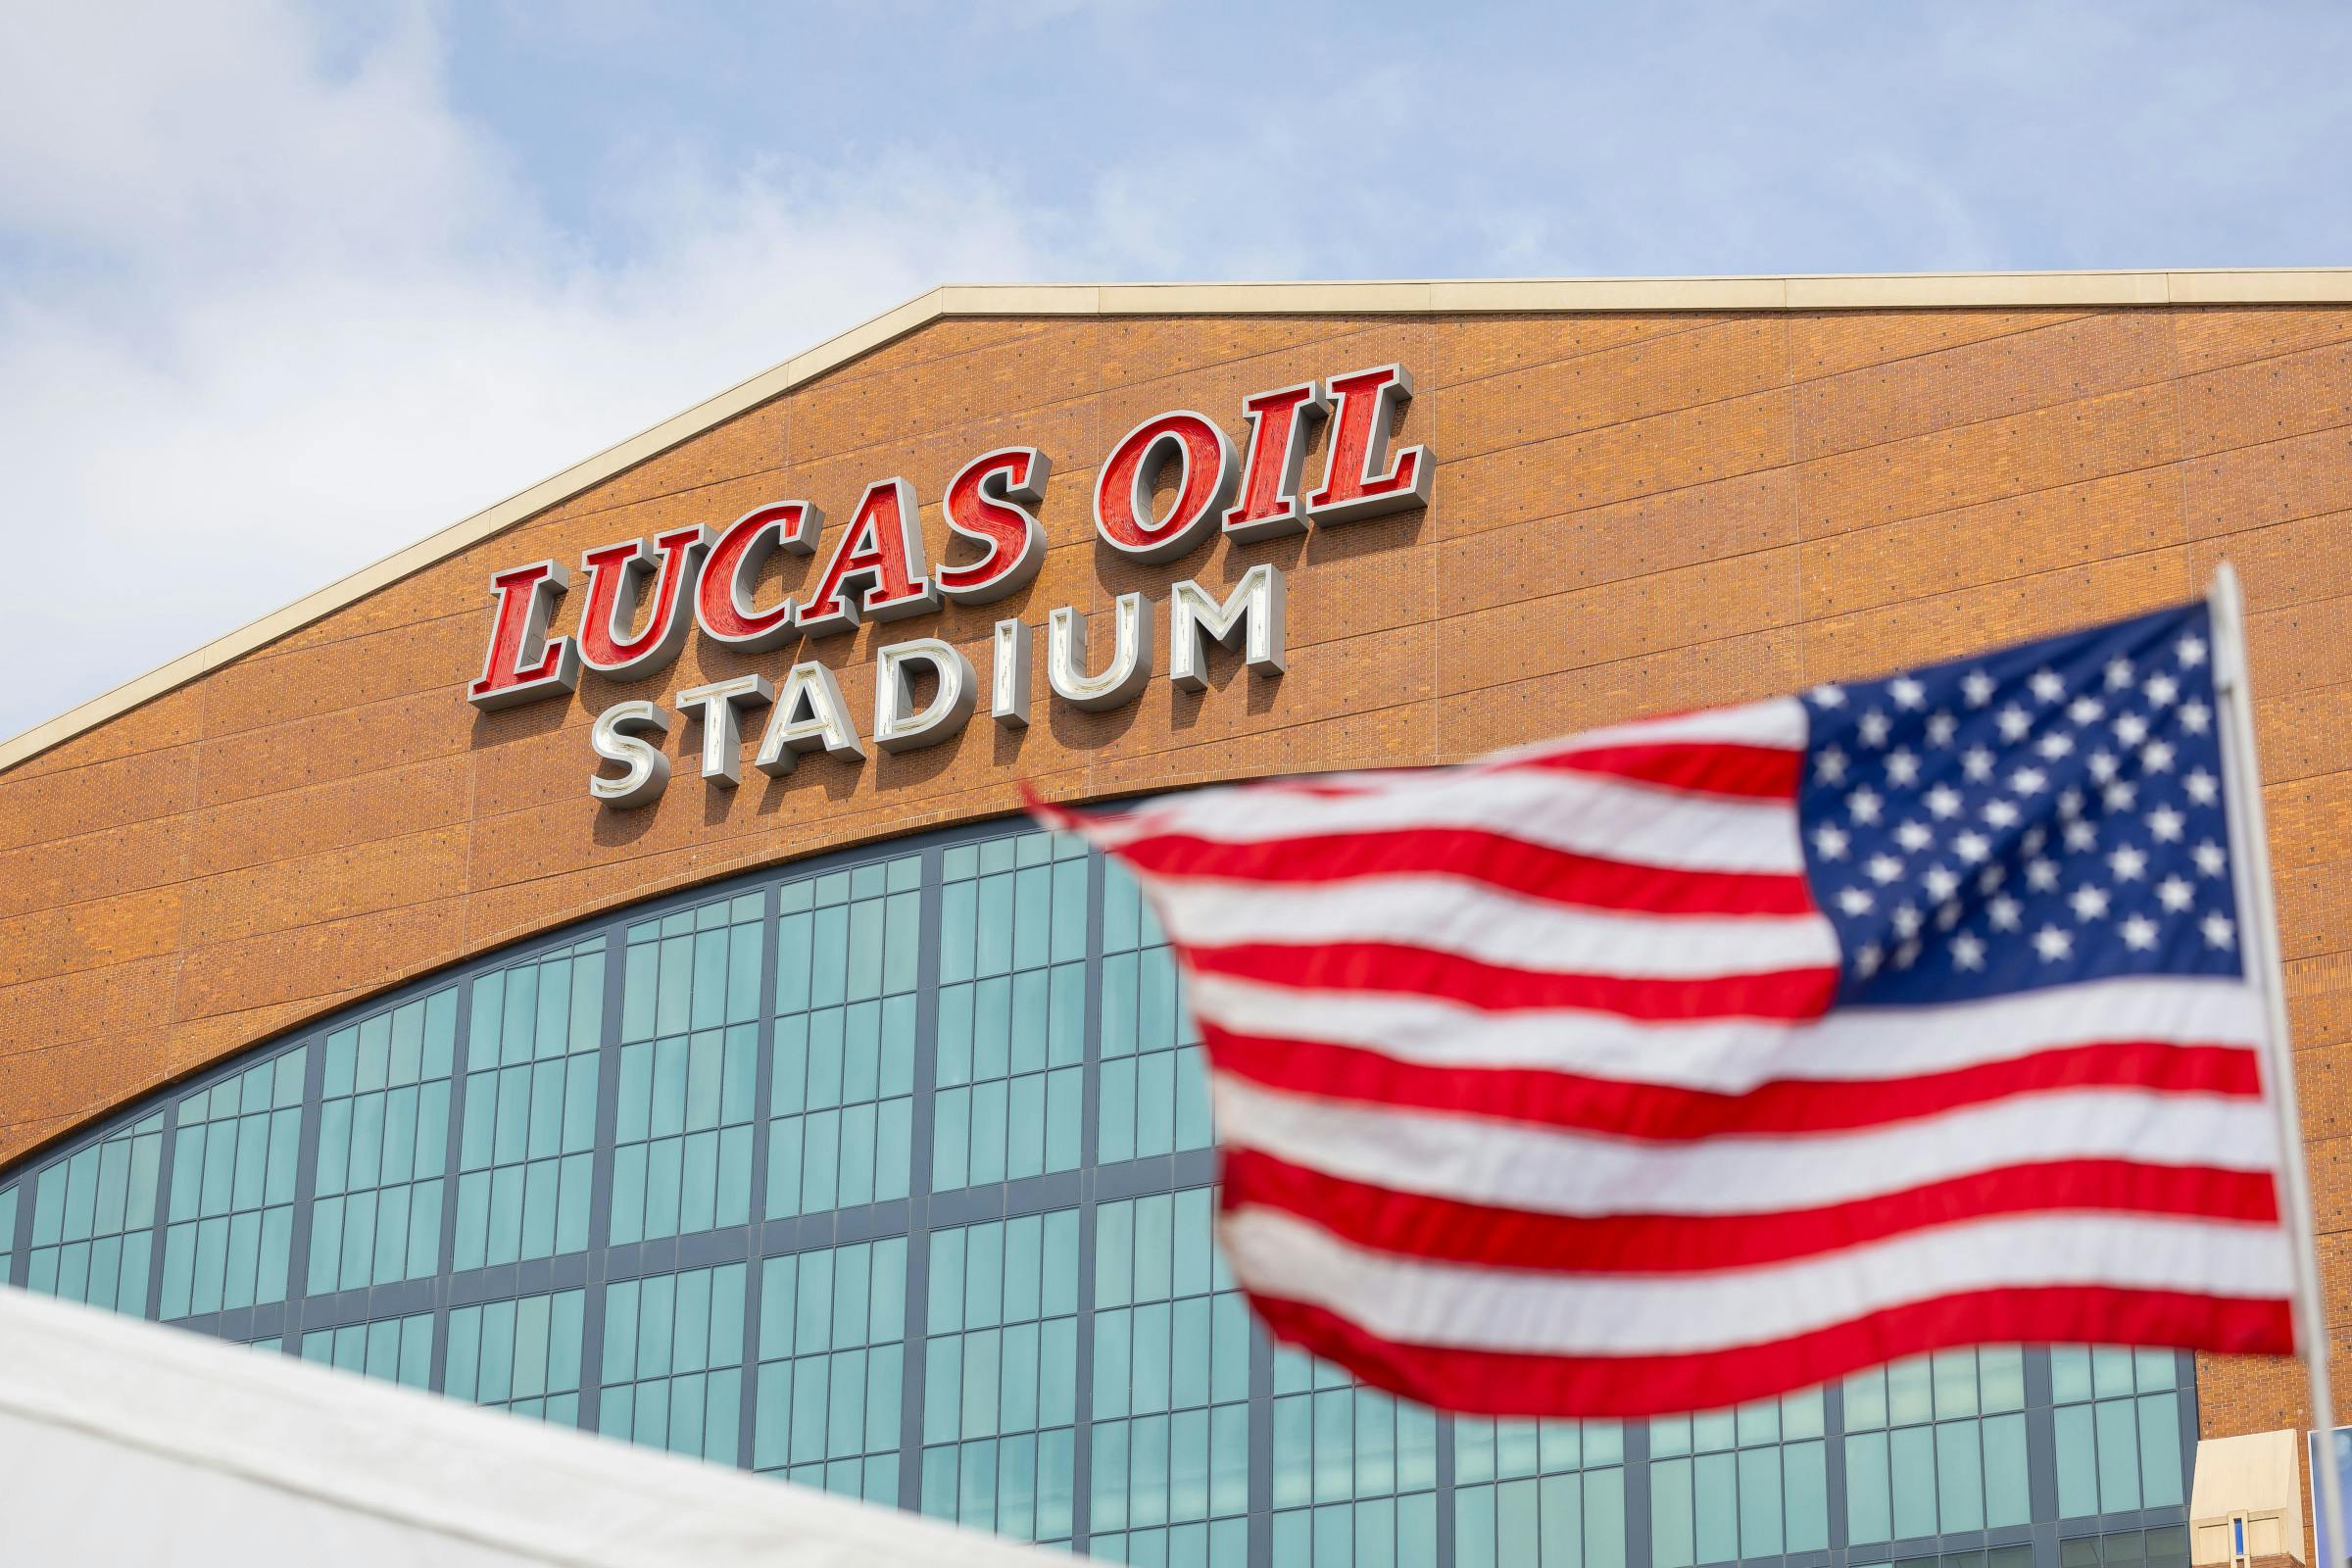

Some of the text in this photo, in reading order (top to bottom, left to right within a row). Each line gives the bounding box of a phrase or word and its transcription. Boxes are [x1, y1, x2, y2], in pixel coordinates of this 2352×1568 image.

[466, 363, 1435, 711] LUCAS OIL
[589, 563, 1285, 808] STADIUM
